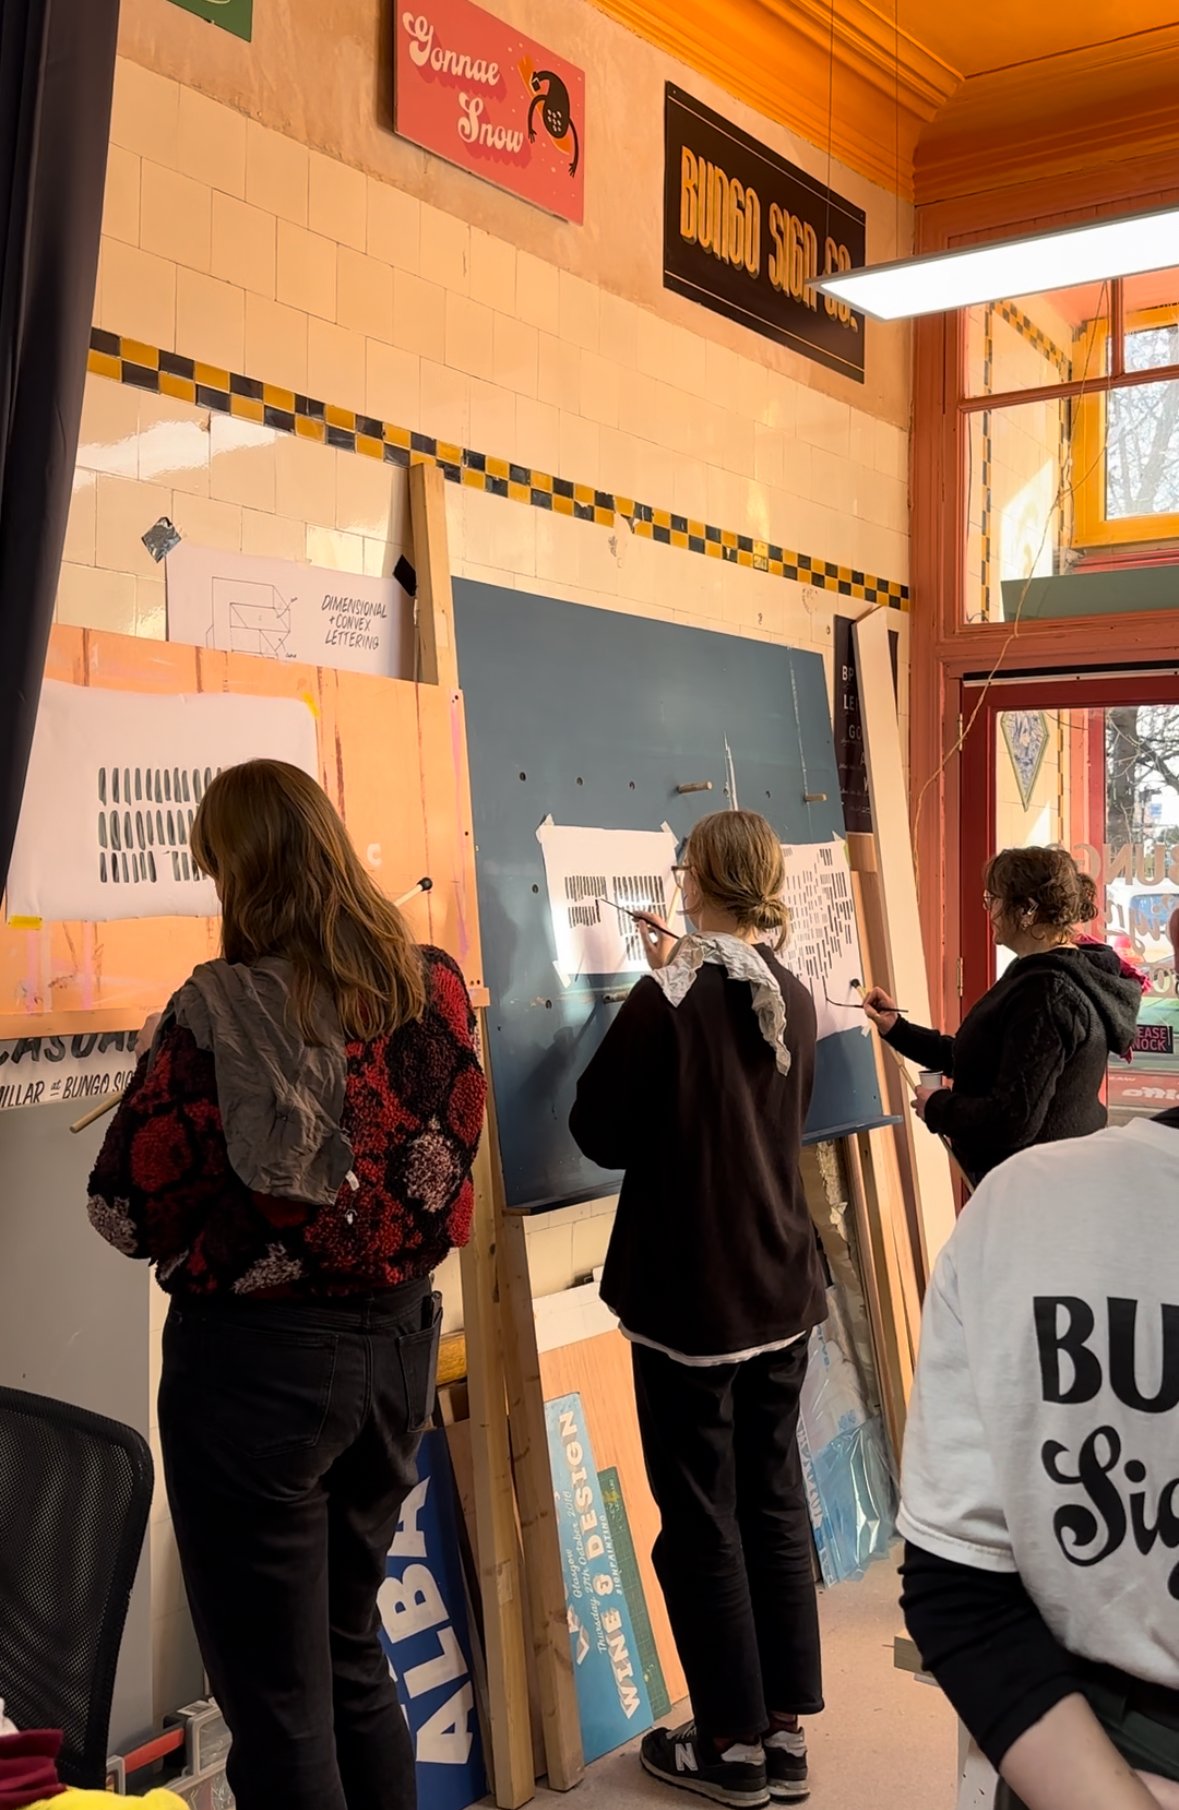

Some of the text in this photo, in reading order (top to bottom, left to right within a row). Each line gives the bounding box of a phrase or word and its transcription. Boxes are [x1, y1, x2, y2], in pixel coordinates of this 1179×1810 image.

[402, 12, 500, 87] Gonnae
[457, 91, 524, 154] Snow
[680, 145, 761, 277] BUNGO
[768, 202, 818, 311] SIGN
[321, 594, 388, 619] DIMENSIONAL
[324, 629, 380, 650] LETTERING
[1131, 1039, 1168, 1052] NOCK
[1137, 1026, 1168, 1040] EASE
[62, 1073, 110, 1100] BUNGO
[559, 1410, 605, 1561] DESIGN
[572, 1521, 588, 1566] October
[376, 1475, 476, 1765] ALBA
[600, 1606, 641, 1720] WINE
